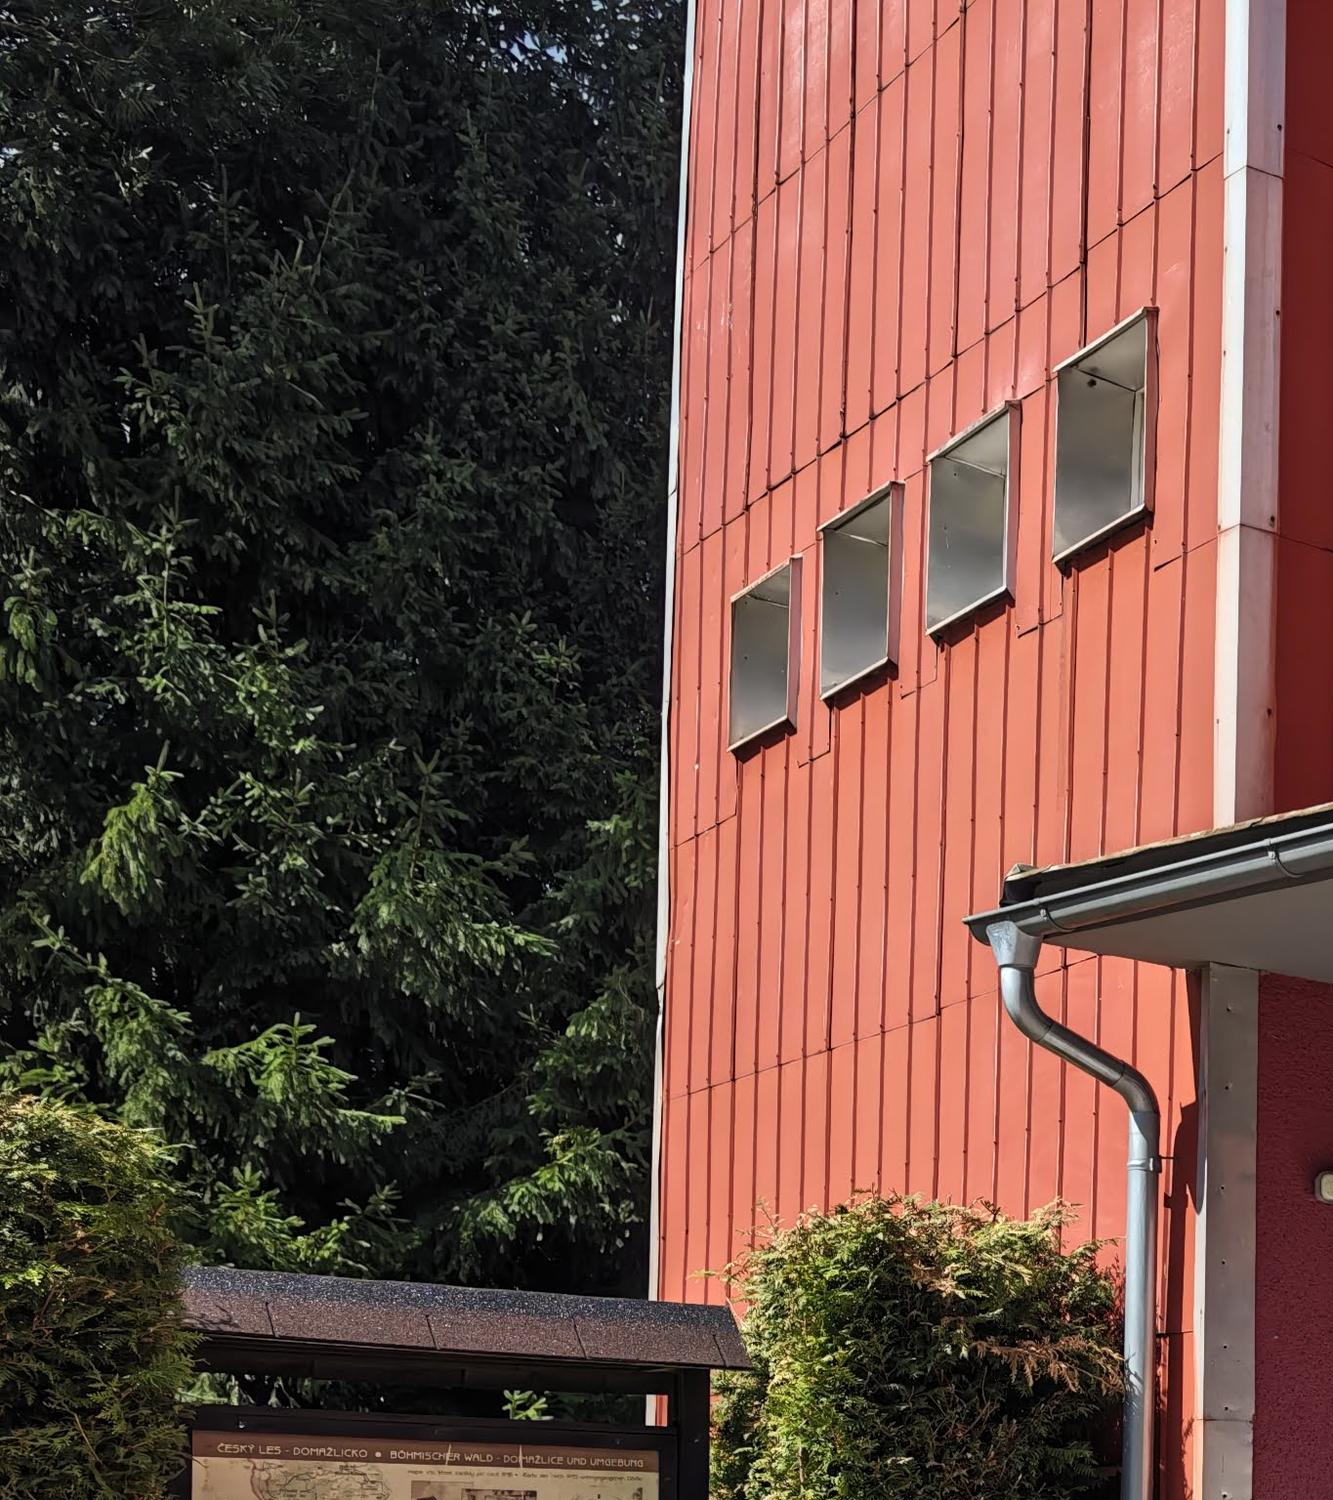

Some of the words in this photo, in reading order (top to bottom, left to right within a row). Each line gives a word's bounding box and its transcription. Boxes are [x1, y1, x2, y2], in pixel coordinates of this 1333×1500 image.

[216, 1442, 255, 1454] ČESKÝ
[258, 1445, 282, 1455] LES
[293, 1446, 368, 1458] DOMAŽLICKO
[390, 1450, 461, 1462] BÖHMISCHER
[463, 1454, 494, 1463] WALD
[503, 1454, 564, 1465] DOMAŽLICE
[566, 1457, 587, 1466] UND
[589, 1457, 645, 1468] UMGEBUNG
